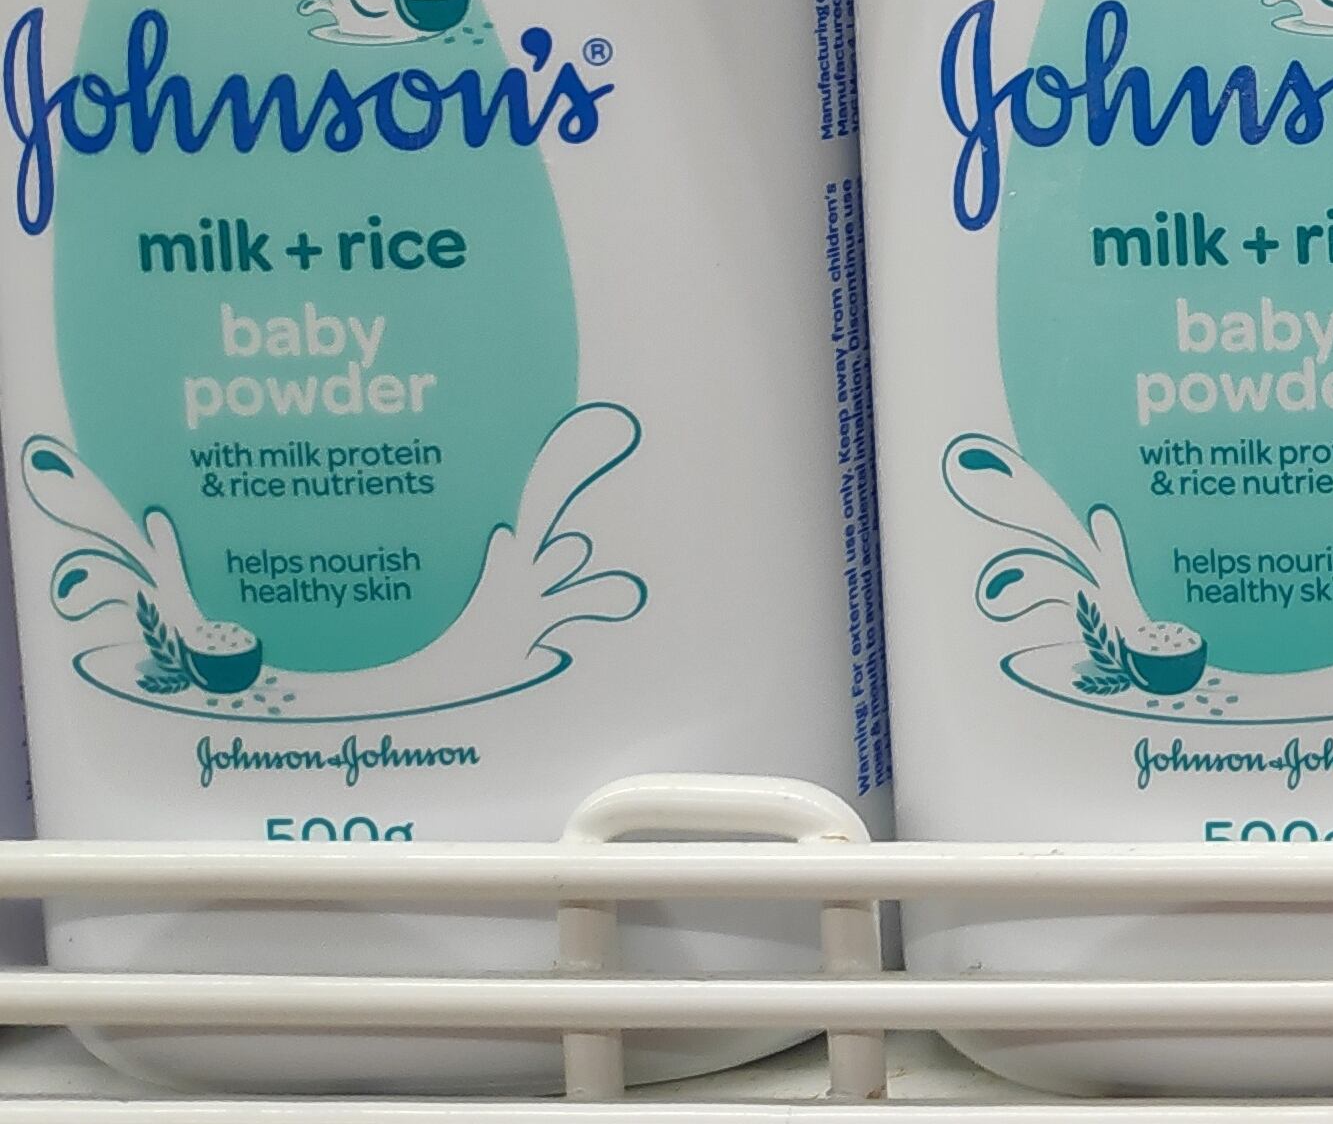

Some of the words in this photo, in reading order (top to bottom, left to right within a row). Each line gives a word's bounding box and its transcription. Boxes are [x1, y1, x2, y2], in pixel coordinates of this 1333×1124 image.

[816, 6, 834, 140] Manufacturing
[139, 218, 272, 273] milk
[286, 232, 322, 271] +
[338, 216, 467, 270] rice
[824, 182, 841, 283] children's
[1093, 210, 1228, 267] milk
[1242, 225, 1279, 265] +
[221, 303, 386, 368] baby
[833, 288, 845, 342] from
[184, 362, 437, 430] powder
[837, 348, 849, 403] away
[190, 442, 253, 468] with
[258, 441, 320, 468] milk
[328, 440, 441, 473] protein
[839, 408, 855, 464] Keep
[1140, 440, 1202, 466] with
[1209, 438, 1272, 465] milk
[201, 475, 225, 498] &
[230, 473, 286, 498] rice
[292, 471, 435, 496] nutrients
[1150, 472, 1174, 496] &
[1179, 471, 1235, 496] rice
[226, 550, 302, 577] helps
[309, 547, 421, 572] nourish
[846, 525, 857, 563] use
[1174, 548, 1251, 577] helps
[241, 579, 347, 608] healthy
[352, 577, 412, 601] skin
[845, 567, 862, 657] external
[1187, 579, 1293, 608] healthy
[853, 663, 865, 698] For
